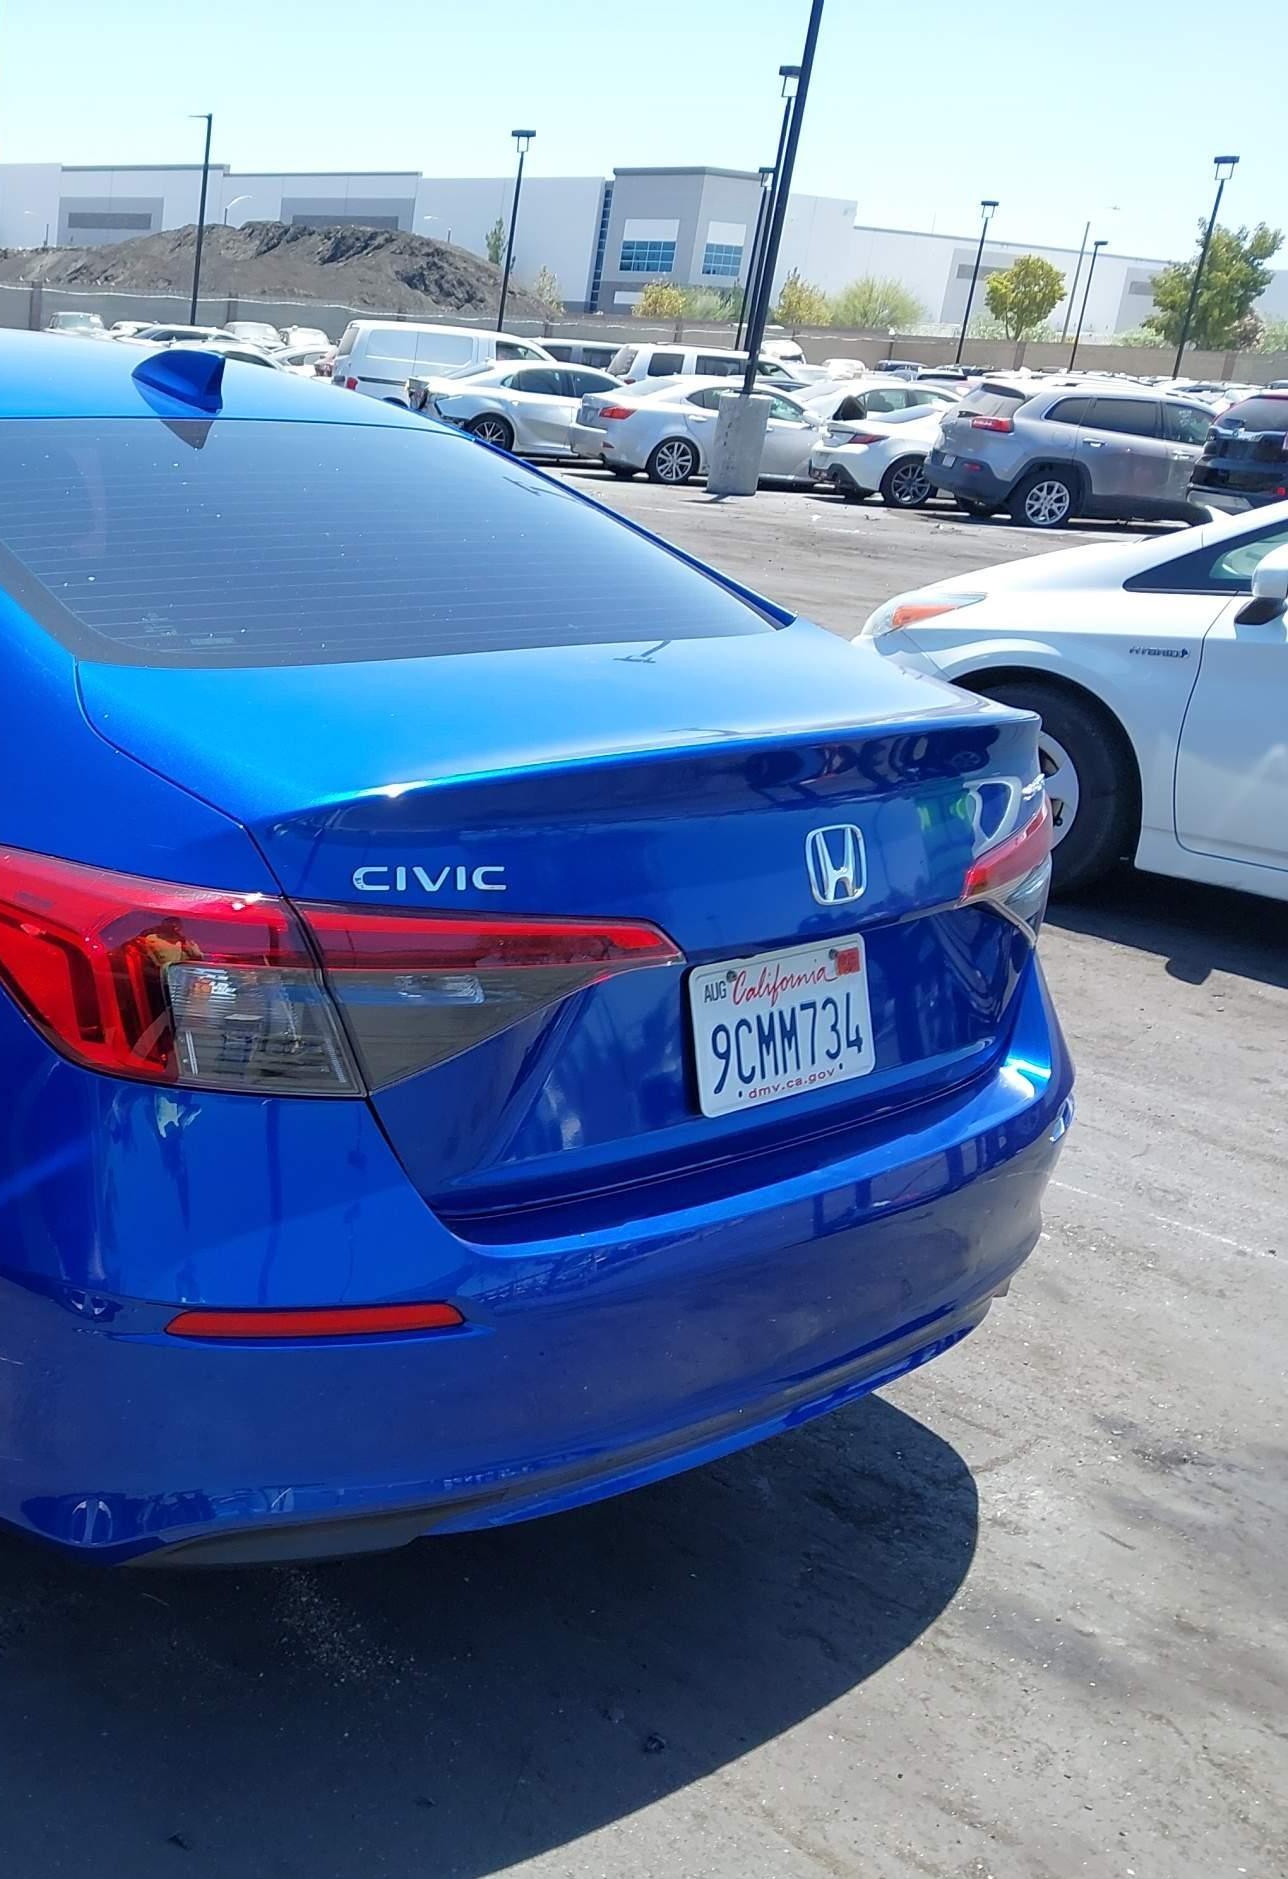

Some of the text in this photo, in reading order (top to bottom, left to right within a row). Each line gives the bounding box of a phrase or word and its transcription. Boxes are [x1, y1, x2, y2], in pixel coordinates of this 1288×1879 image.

[352, 866, 507, 892] CIVIC
[704, 980, 727, 1003] AUG
[732, 960, 838, 1007] California
[711, 992, 862, 1095] 9CMM734
[748, 1066, 835, 1099] dmv.ca.gov
